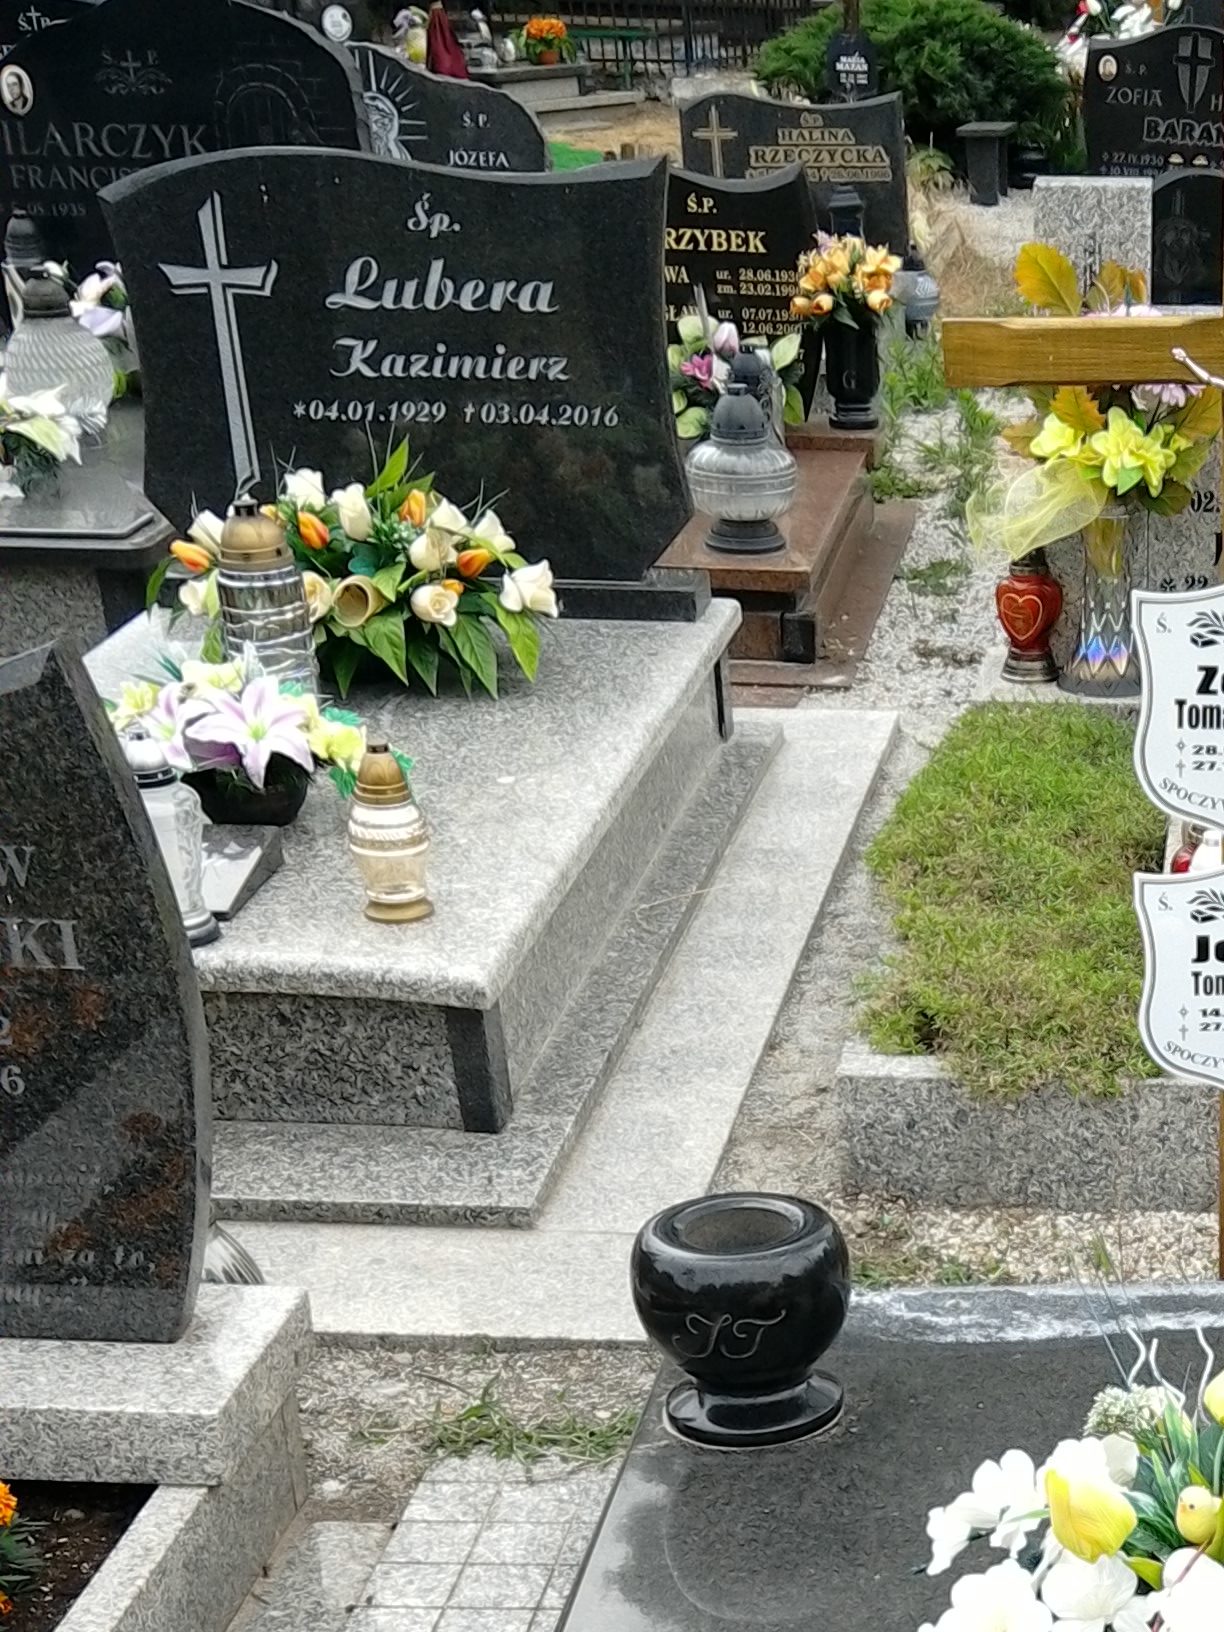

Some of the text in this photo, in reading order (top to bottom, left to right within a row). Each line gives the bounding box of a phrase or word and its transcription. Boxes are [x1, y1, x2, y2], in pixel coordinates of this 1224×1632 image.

[1105, 86, 1164, 107] ZOFIA
[779, 129, 854, 143] HALINA
[752, 147, 888, 166] RZECZYCKA
[686, 192, 718, 214] Ś.P.
[324, 255, 560, 313] Lubera
[329, 336, 571, 381] Kazimierz
